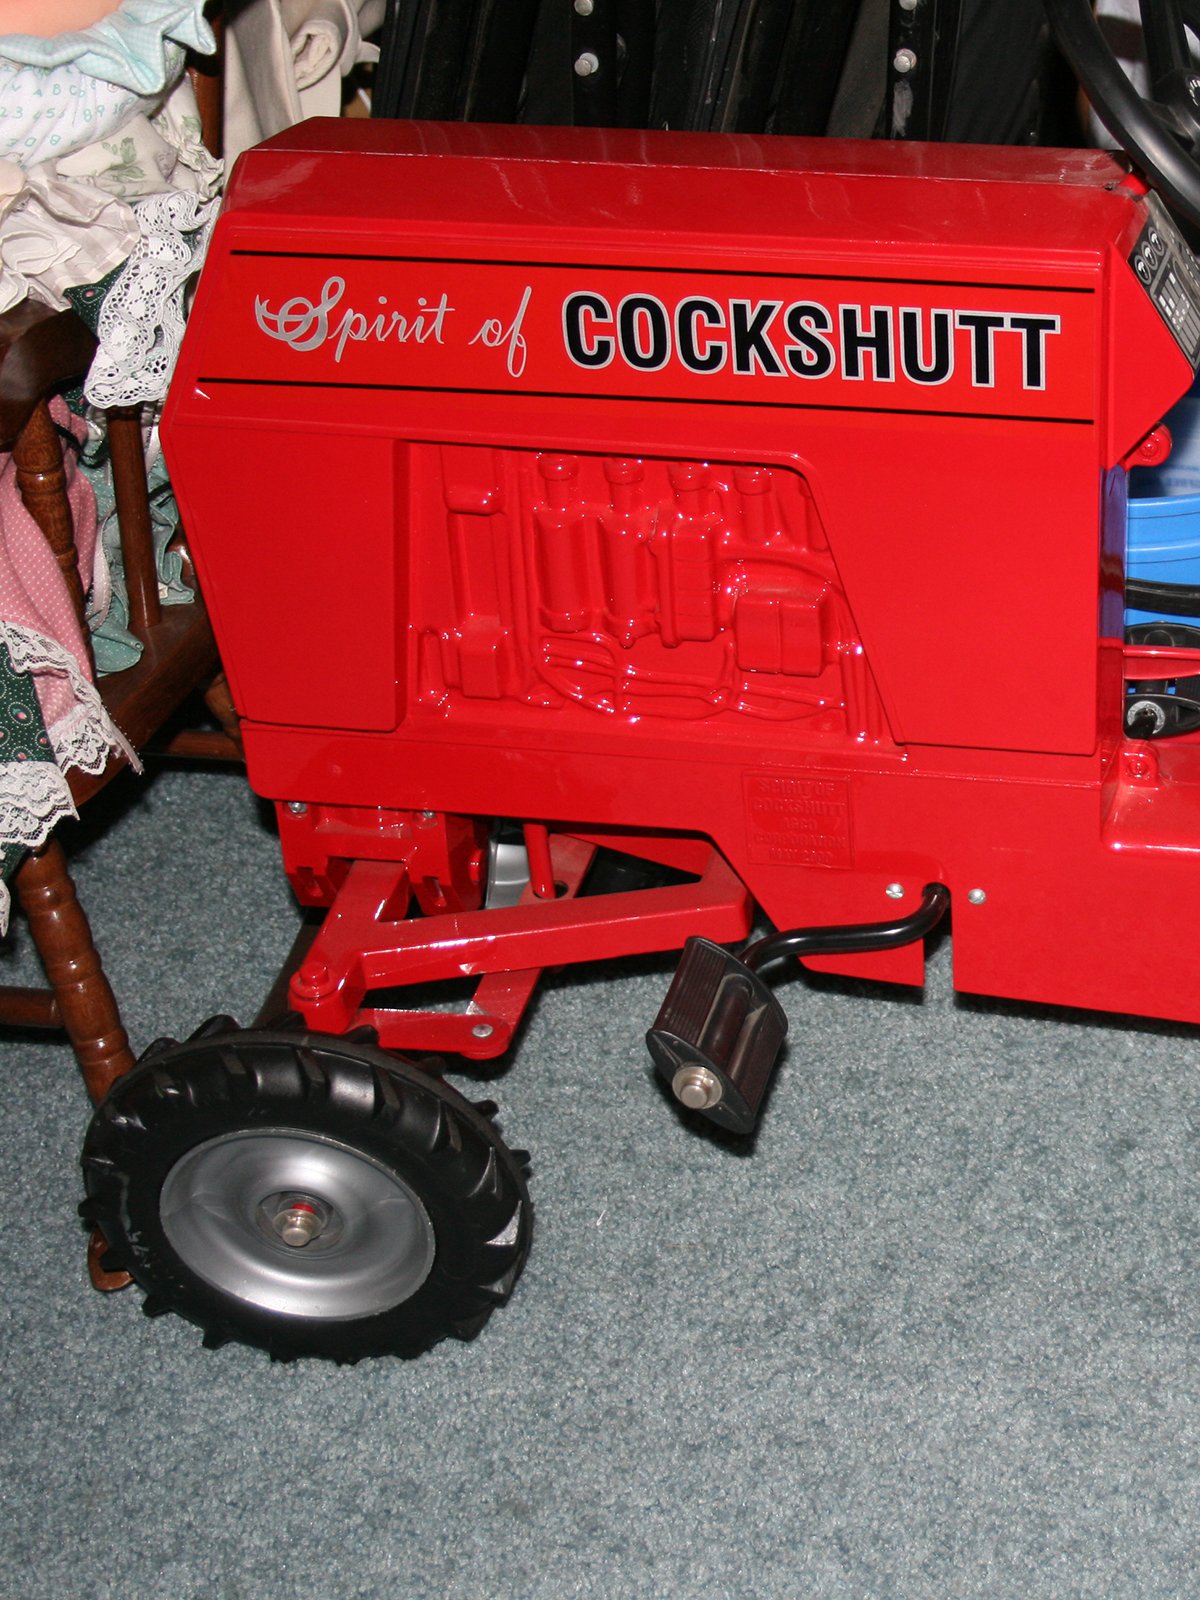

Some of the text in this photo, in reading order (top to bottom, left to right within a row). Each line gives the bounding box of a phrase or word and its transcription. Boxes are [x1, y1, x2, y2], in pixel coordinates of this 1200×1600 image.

[254, 276, 1061, 391] Spirit of COCKSHUTT
